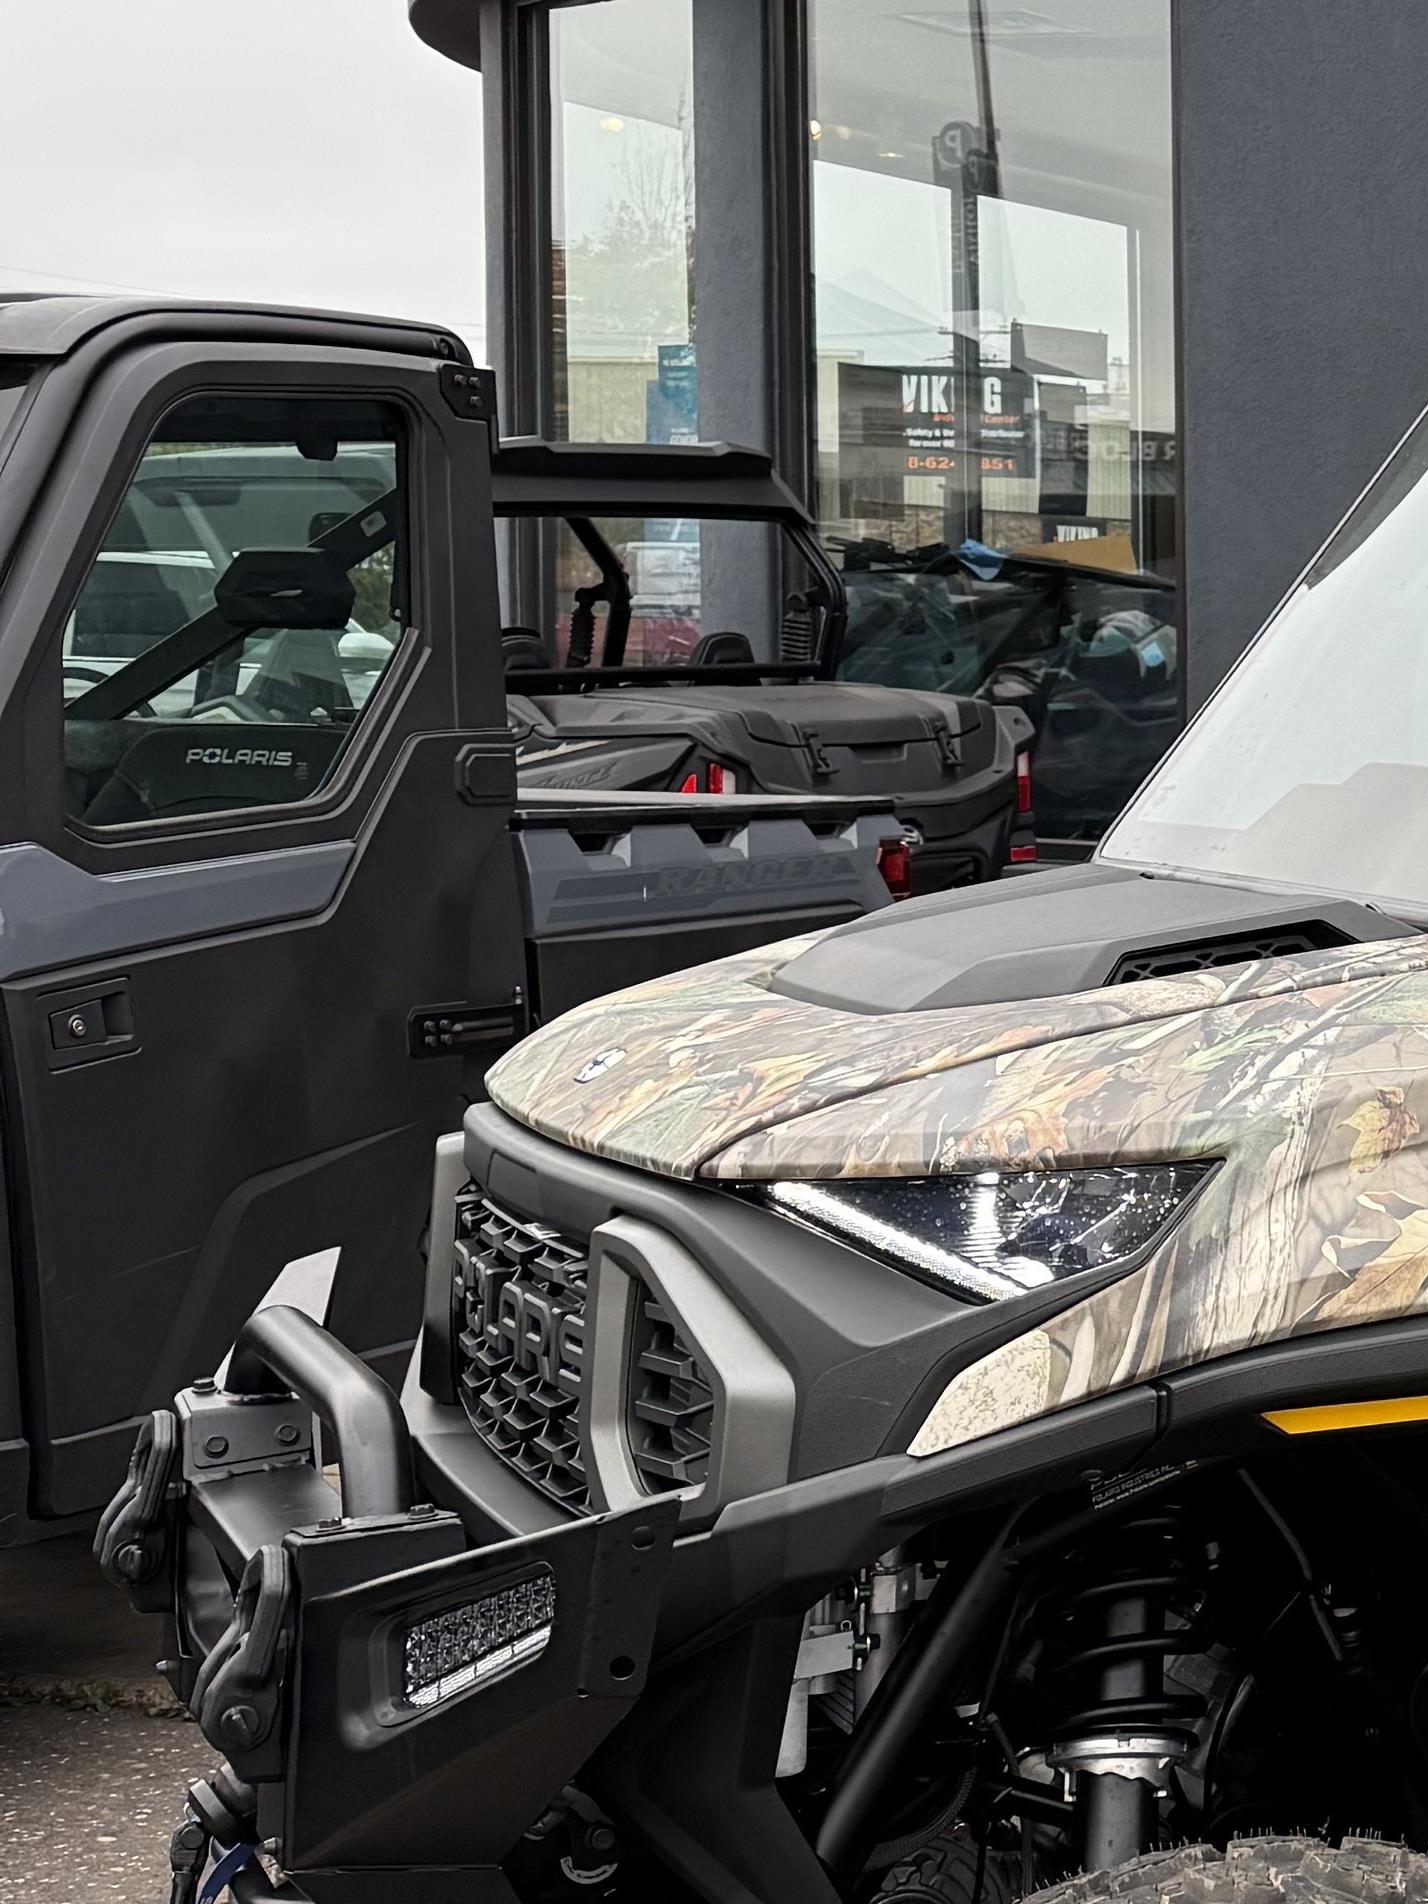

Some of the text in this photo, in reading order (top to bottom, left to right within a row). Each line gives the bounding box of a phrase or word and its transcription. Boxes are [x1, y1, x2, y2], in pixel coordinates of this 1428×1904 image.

[902, 375, 1001, 413] VIKG
[185, 748, 293, 766] POLARIS
[652, 855, 840, 898] RANGER
